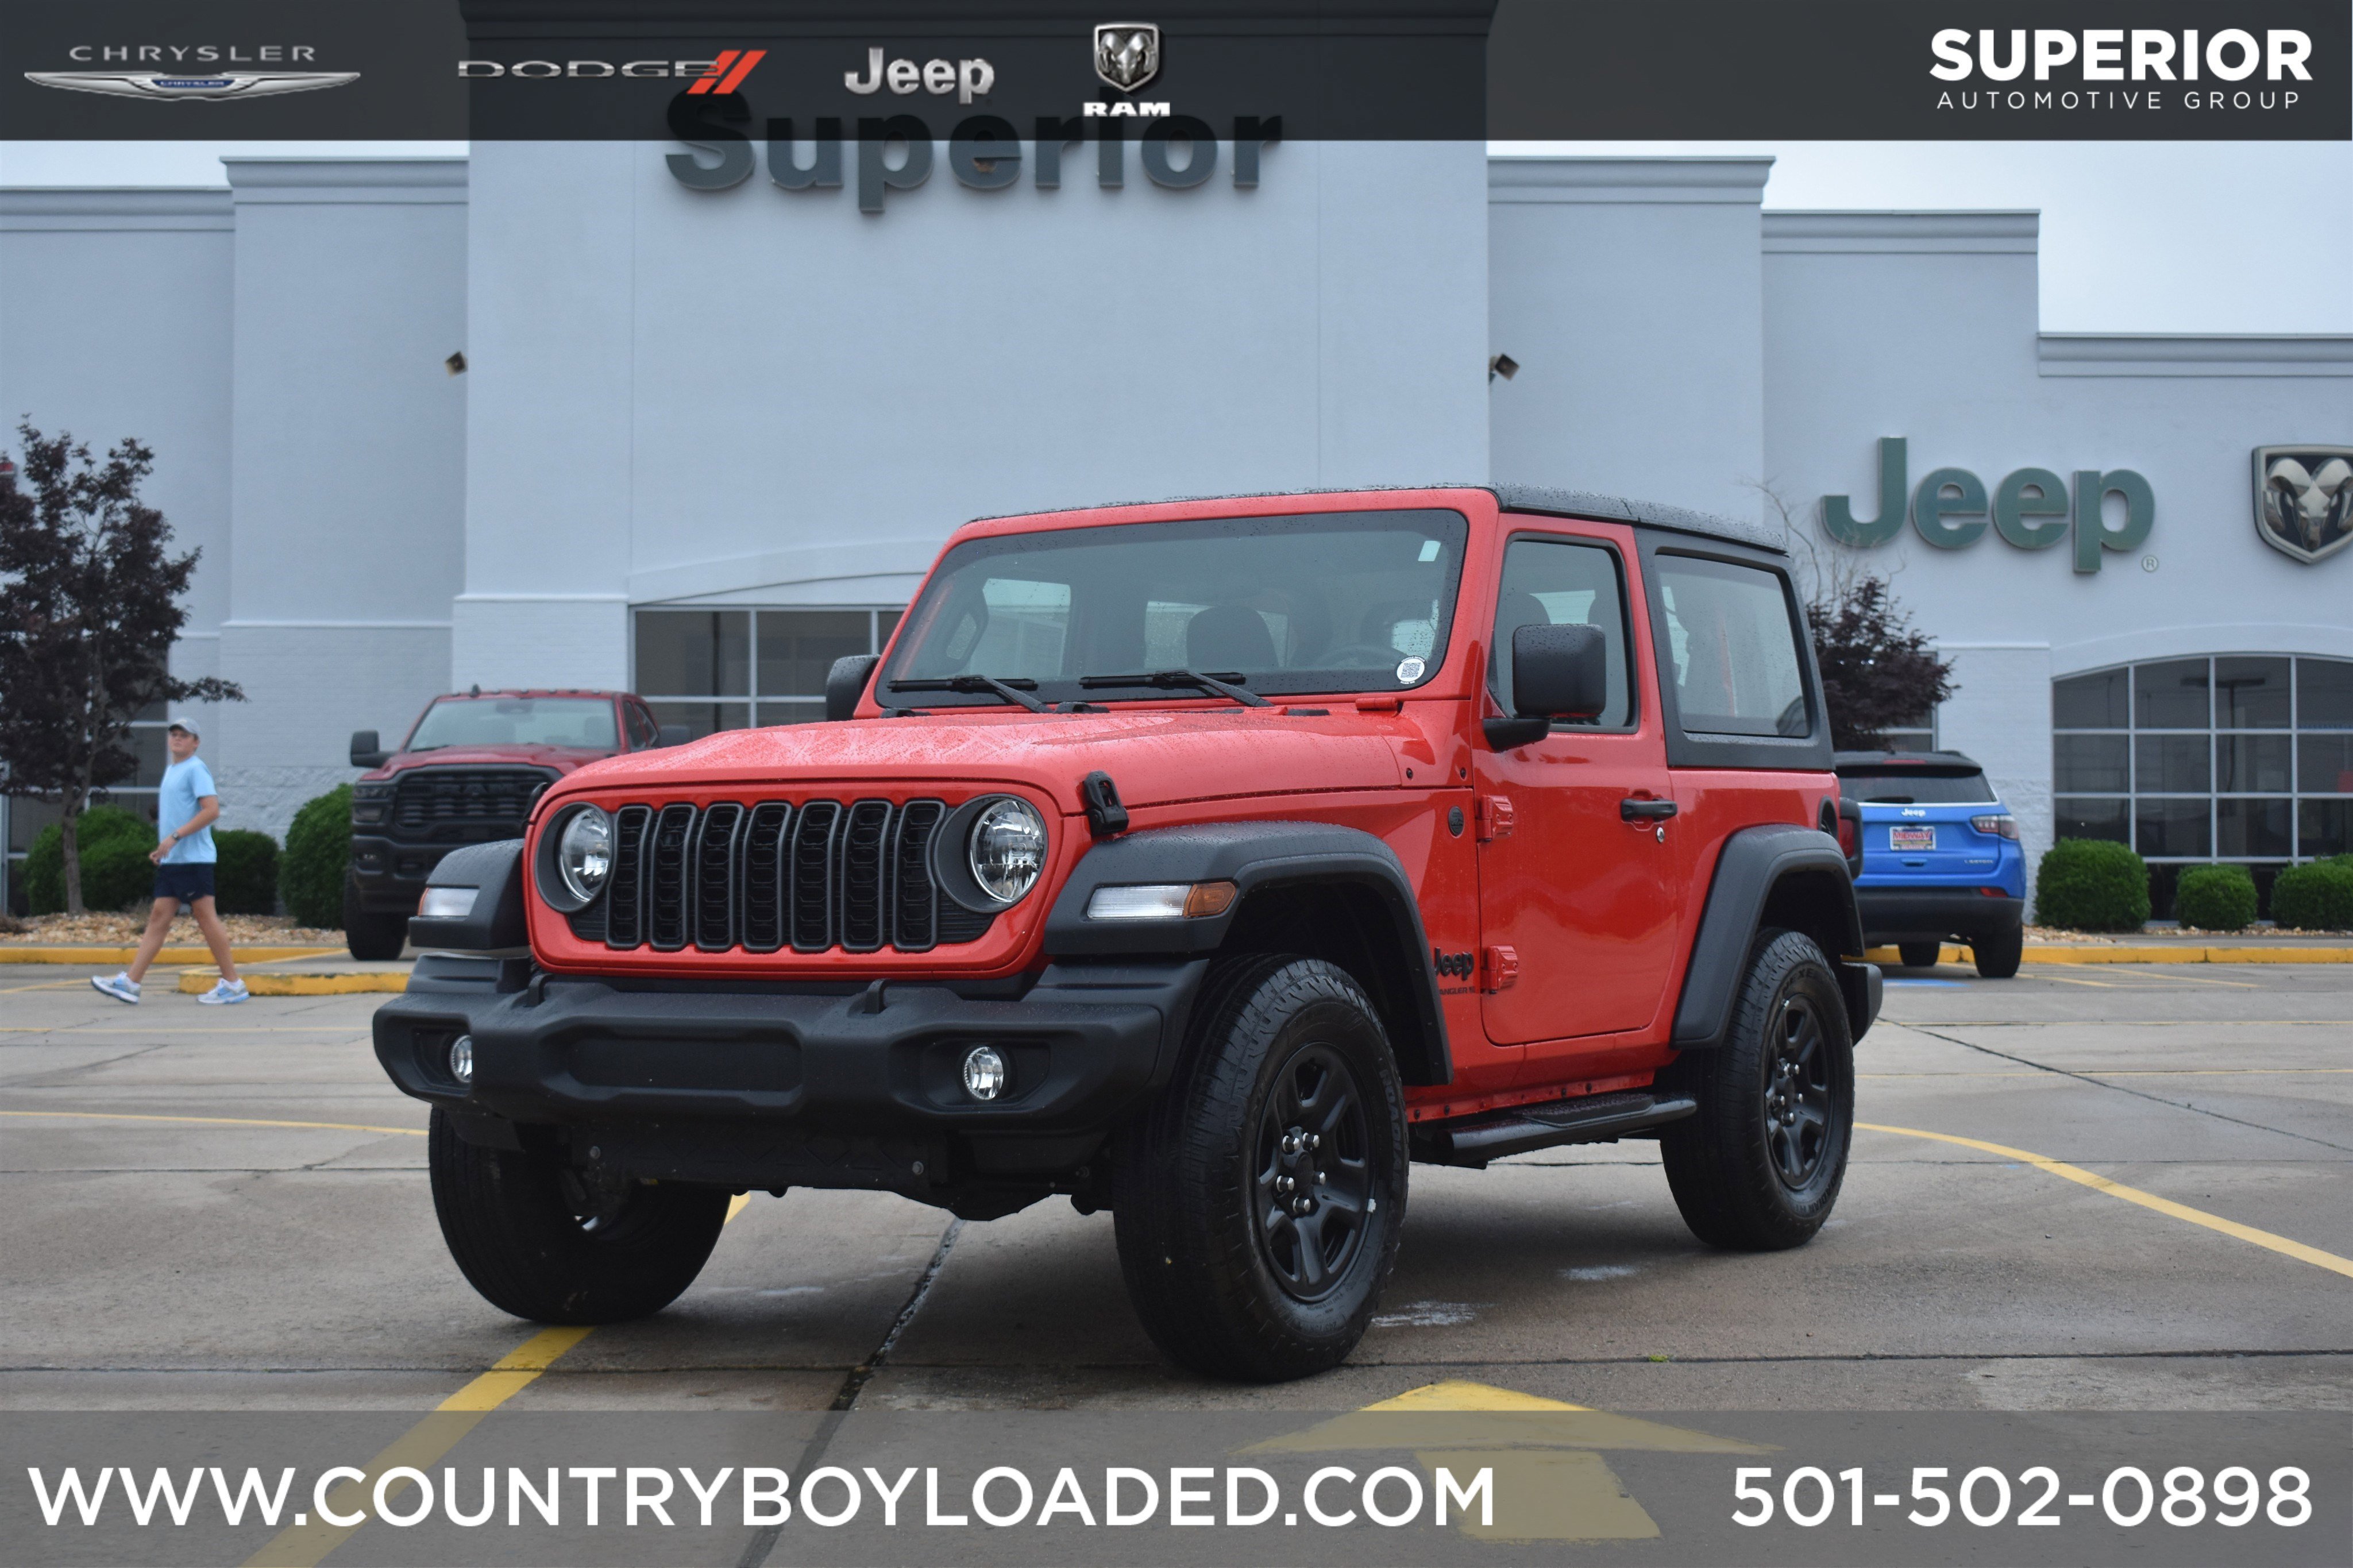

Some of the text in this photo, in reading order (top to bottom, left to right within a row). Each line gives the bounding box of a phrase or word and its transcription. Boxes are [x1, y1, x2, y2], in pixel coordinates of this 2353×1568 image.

[665, 86, 1283, 213] Superior
[1820, 437, 2155, 574] Jeep
[1901, 808, 1926, 818] Jeep
[1434, 947, 1475, 981] Jeep
[1439, 987, 1468, 995] ANGLER
